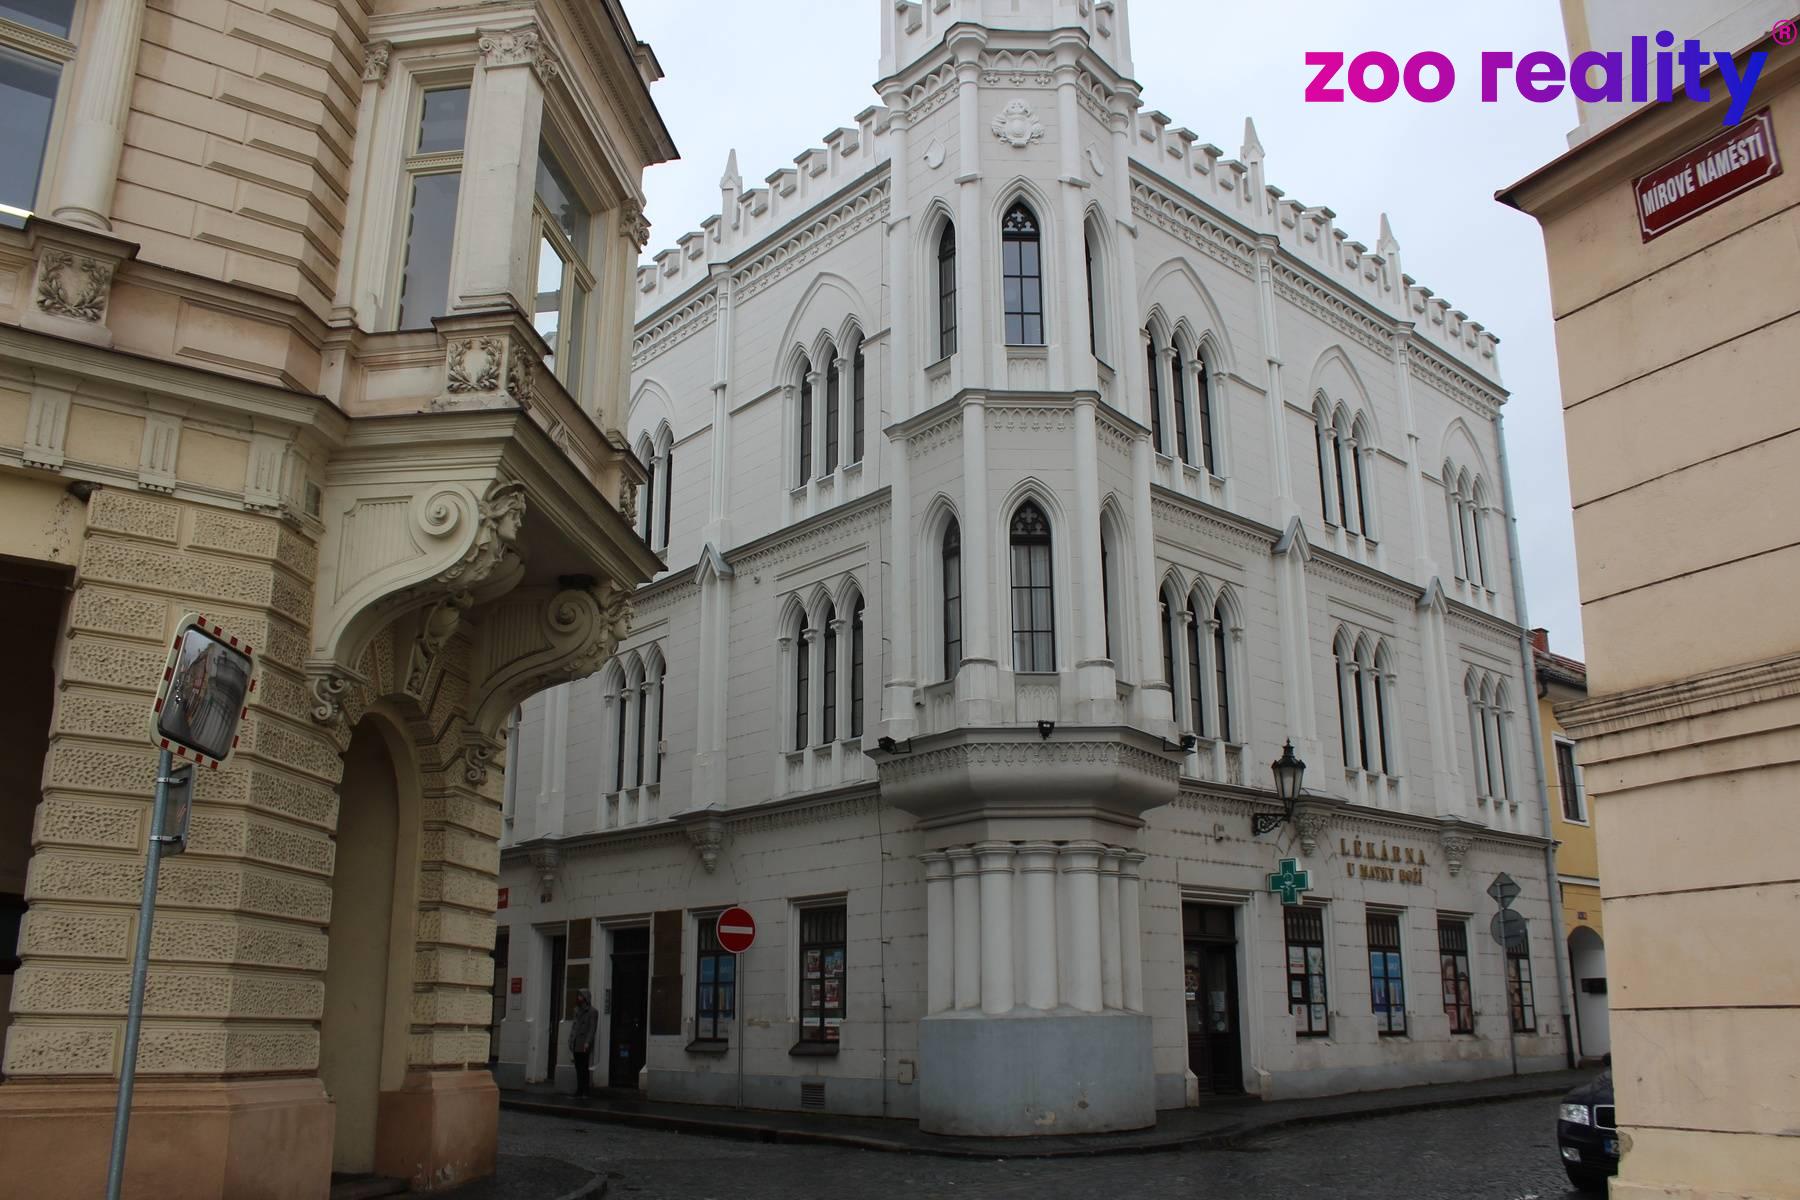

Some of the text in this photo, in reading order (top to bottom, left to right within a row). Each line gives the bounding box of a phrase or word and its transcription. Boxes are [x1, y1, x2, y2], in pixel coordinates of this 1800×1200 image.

[1642, 126, 1765, 217] MÍROVÉ NÁMĚSTÍ
[1340, 834, 1427, 866] LÉKÁRNA
[1346, 862, 1355, 878] U
